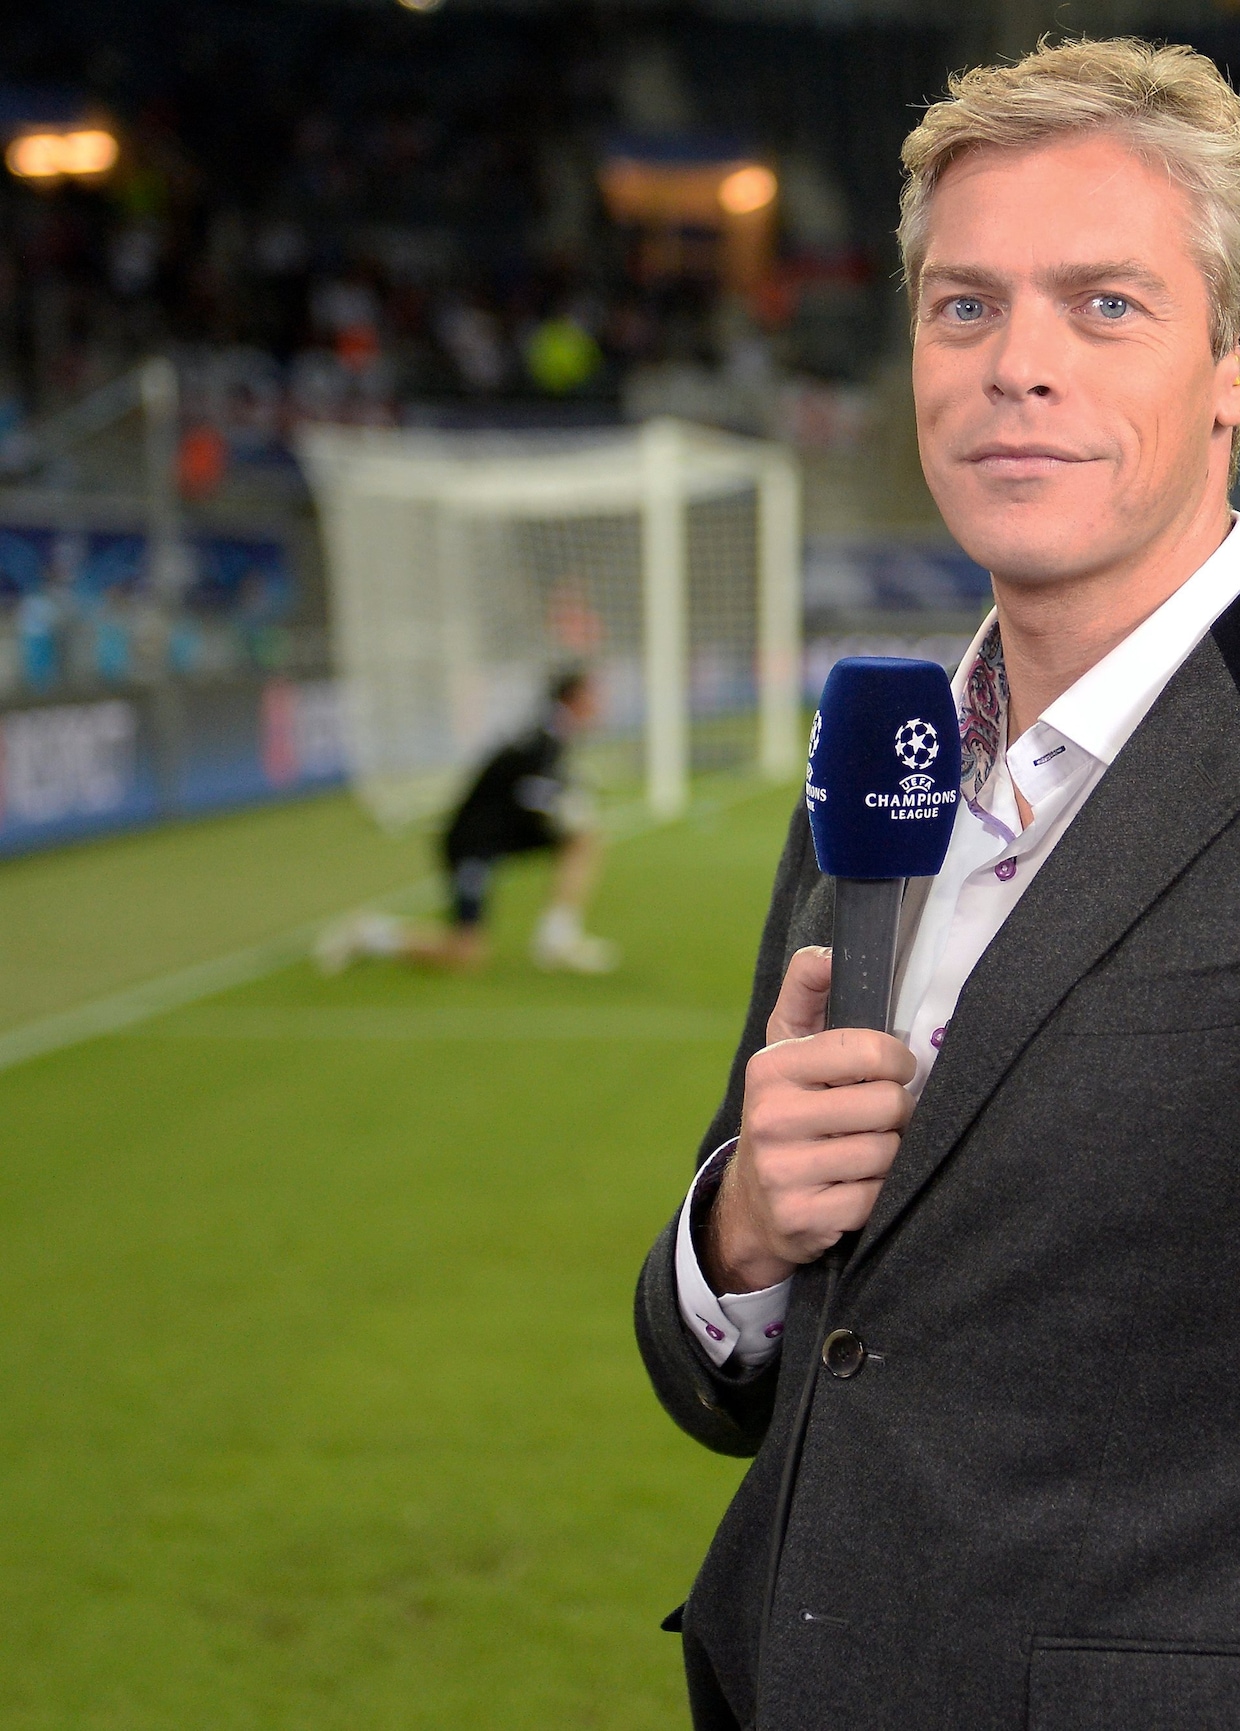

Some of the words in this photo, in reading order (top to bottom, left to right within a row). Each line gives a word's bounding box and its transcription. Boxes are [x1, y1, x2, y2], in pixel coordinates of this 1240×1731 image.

[901, 777, 932, 791] UEFA
[865, 790, 957, 807] CHAMPIONS
[891, 807, 939, 820] LEAGUE
